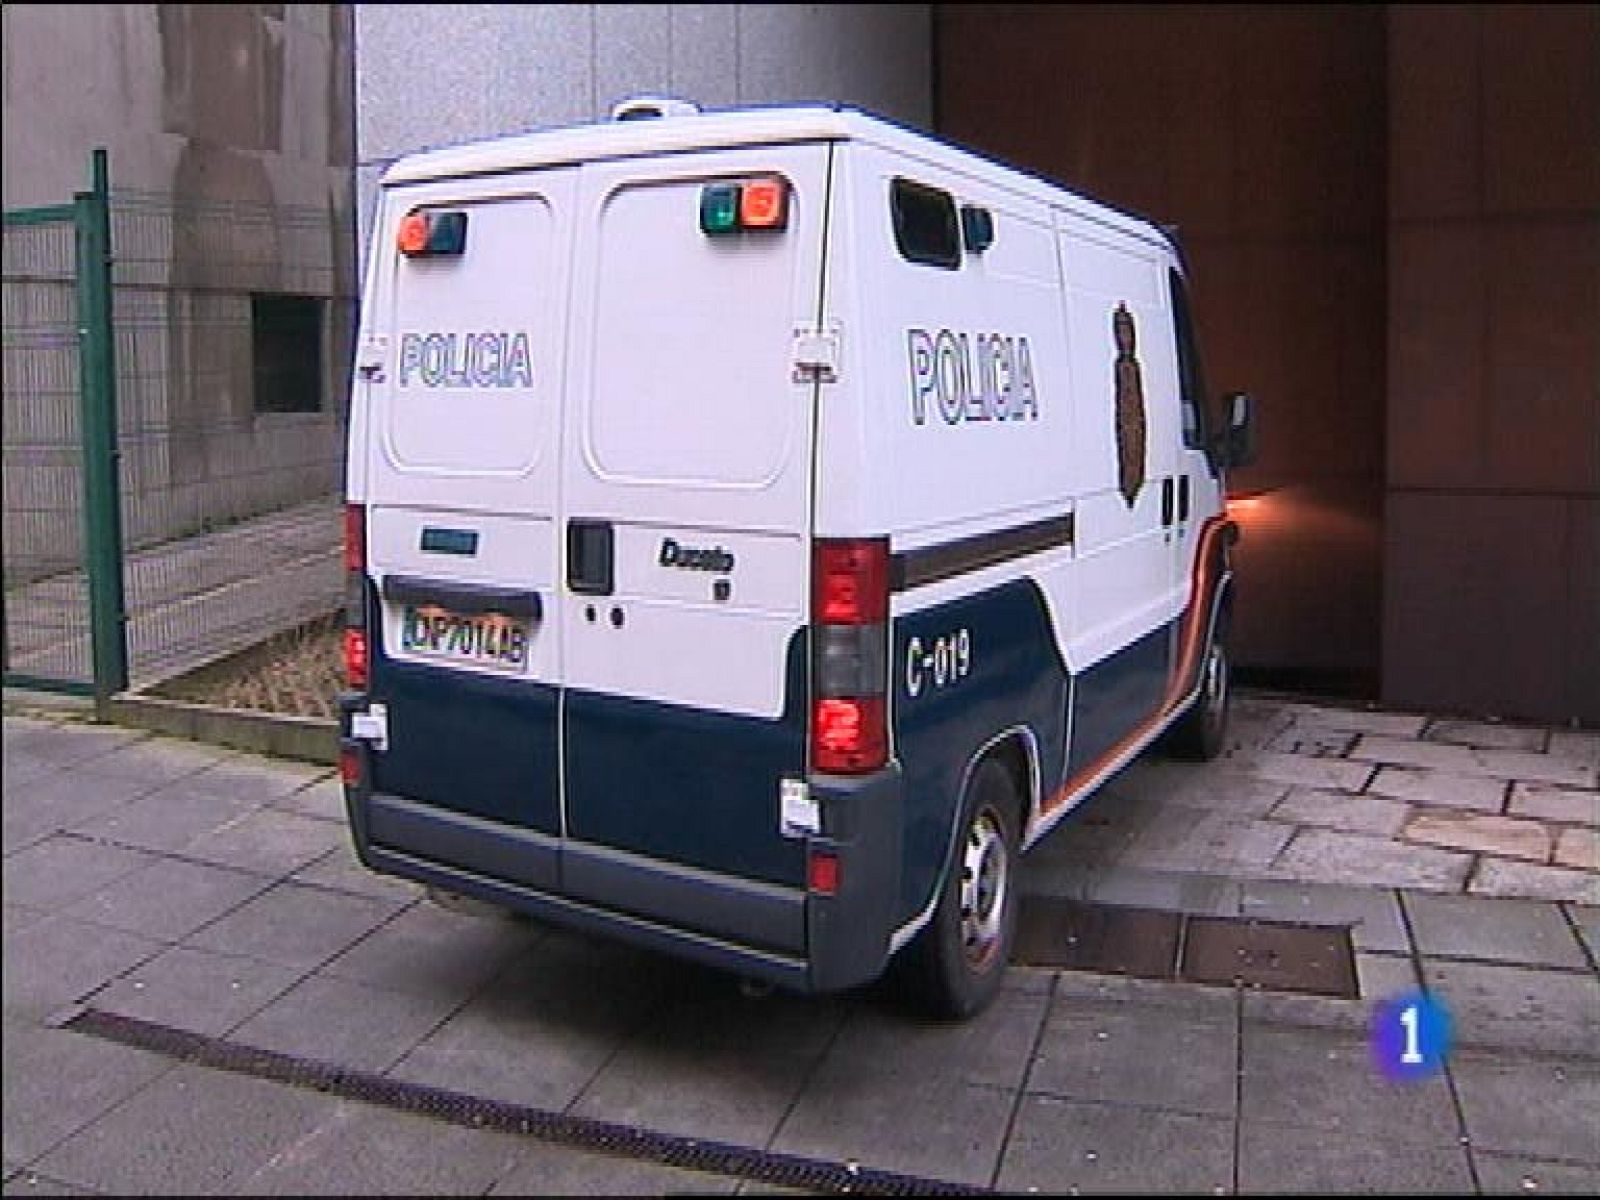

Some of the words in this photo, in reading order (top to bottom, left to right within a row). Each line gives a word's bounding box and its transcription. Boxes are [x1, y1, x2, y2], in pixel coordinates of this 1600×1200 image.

[399, 332, 533, 387] POLICIA
[908, 328, 1038, 425] POLICIA
[907, 628, 970, 696] C-019
